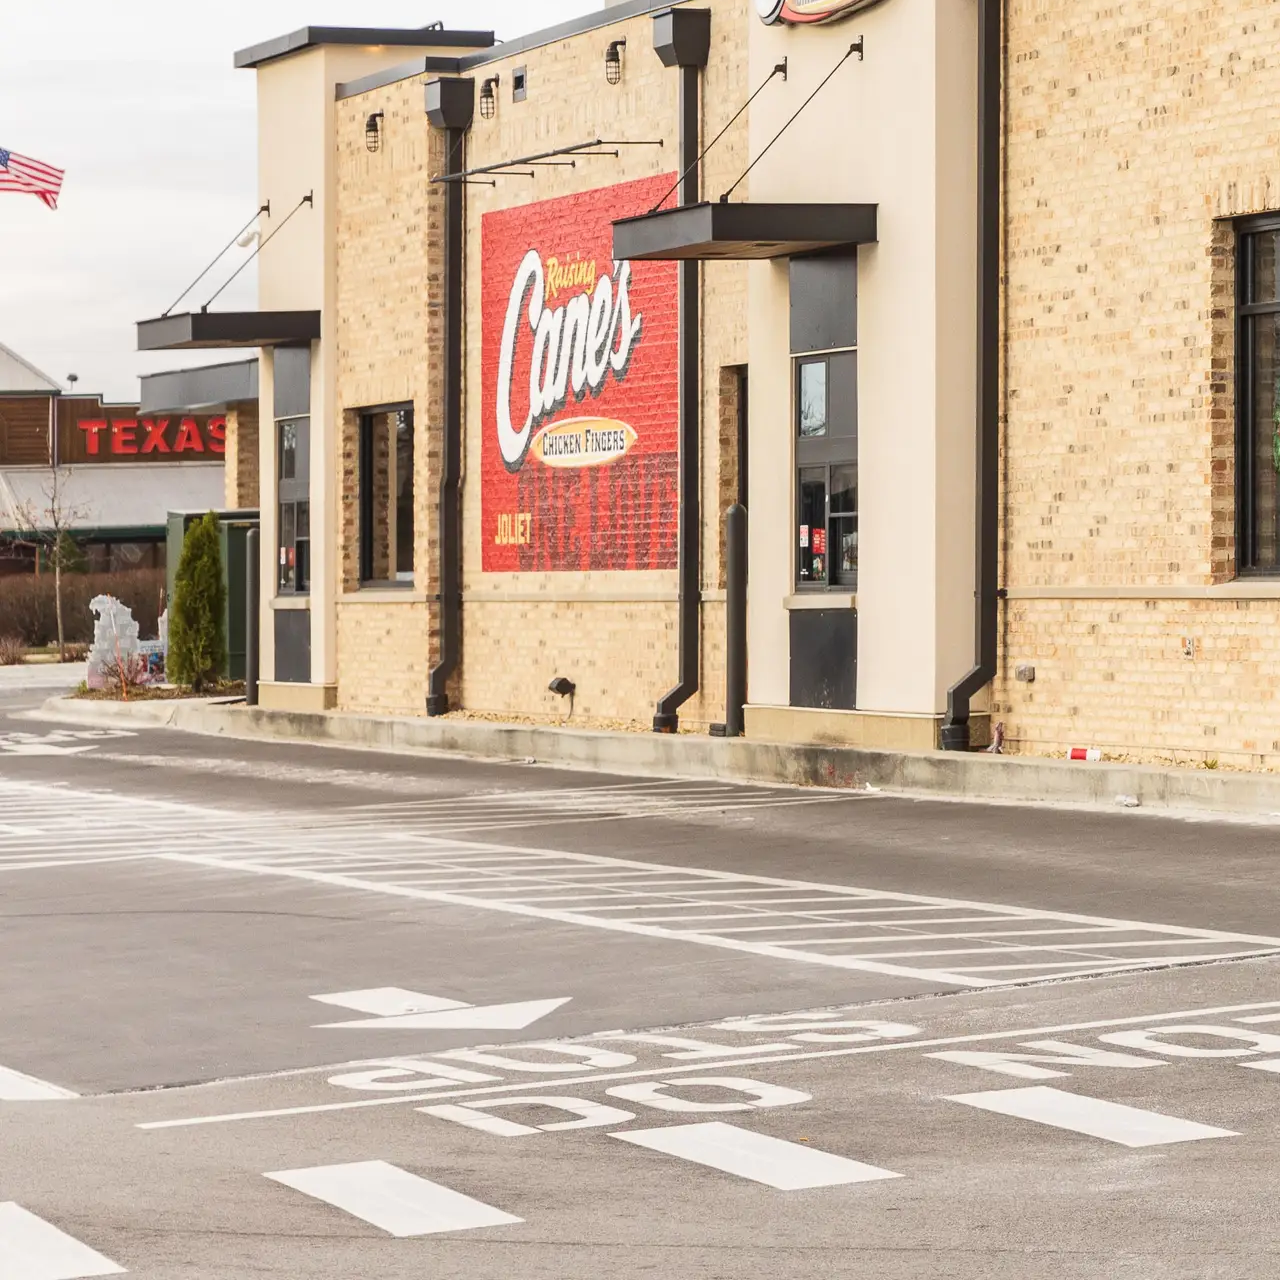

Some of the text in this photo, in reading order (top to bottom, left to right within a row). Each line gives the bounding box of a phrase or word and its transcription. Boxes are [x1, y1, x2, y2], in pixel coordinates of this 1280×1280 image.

[545, 251, 597, 301] Raising
[76, 415, 226, 455] TEXAS
[542, 428, 626, 457] CHICKEN FINGERS
[494, 512, 532, 546] JOLIET
[326, 1011, 924, 1092] STOP
[414, 1075, 814, 1138] DO
